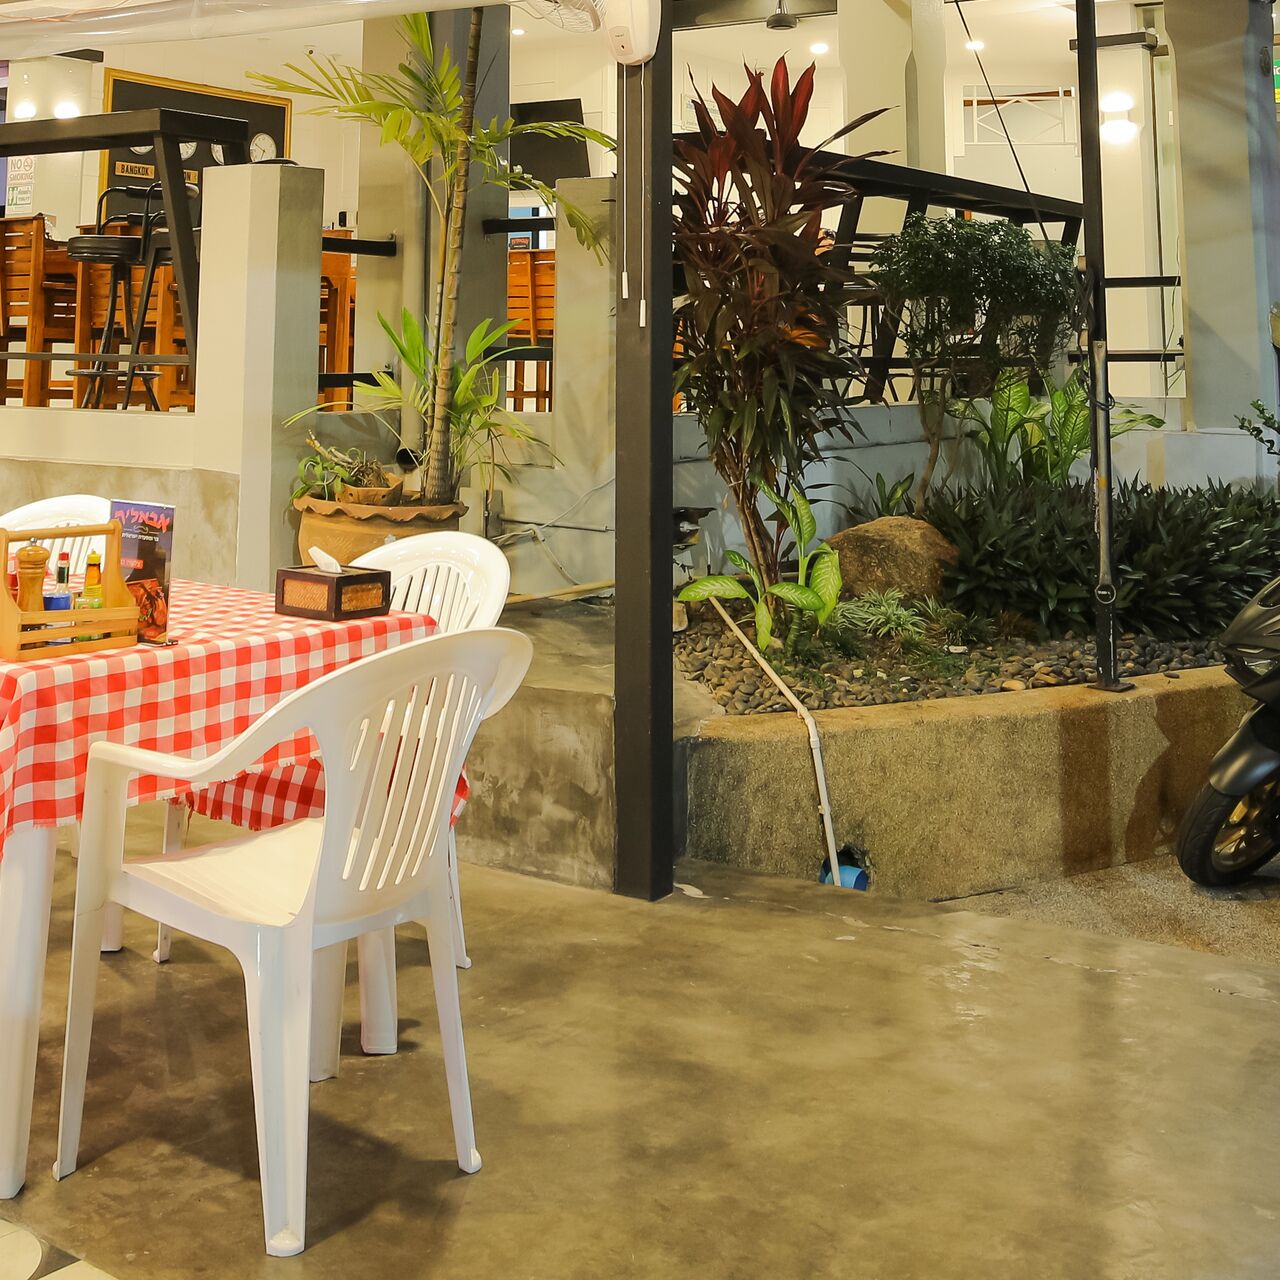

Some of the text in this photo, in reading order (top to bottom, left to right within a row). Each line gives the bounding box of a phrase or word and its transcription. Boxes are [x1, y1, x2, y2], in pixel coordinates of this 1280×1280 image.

[10, 158, 22, 170] NO
[120, 163, 150, 175] BANGKOK
[9, 172, 33, 181] SMOKING
